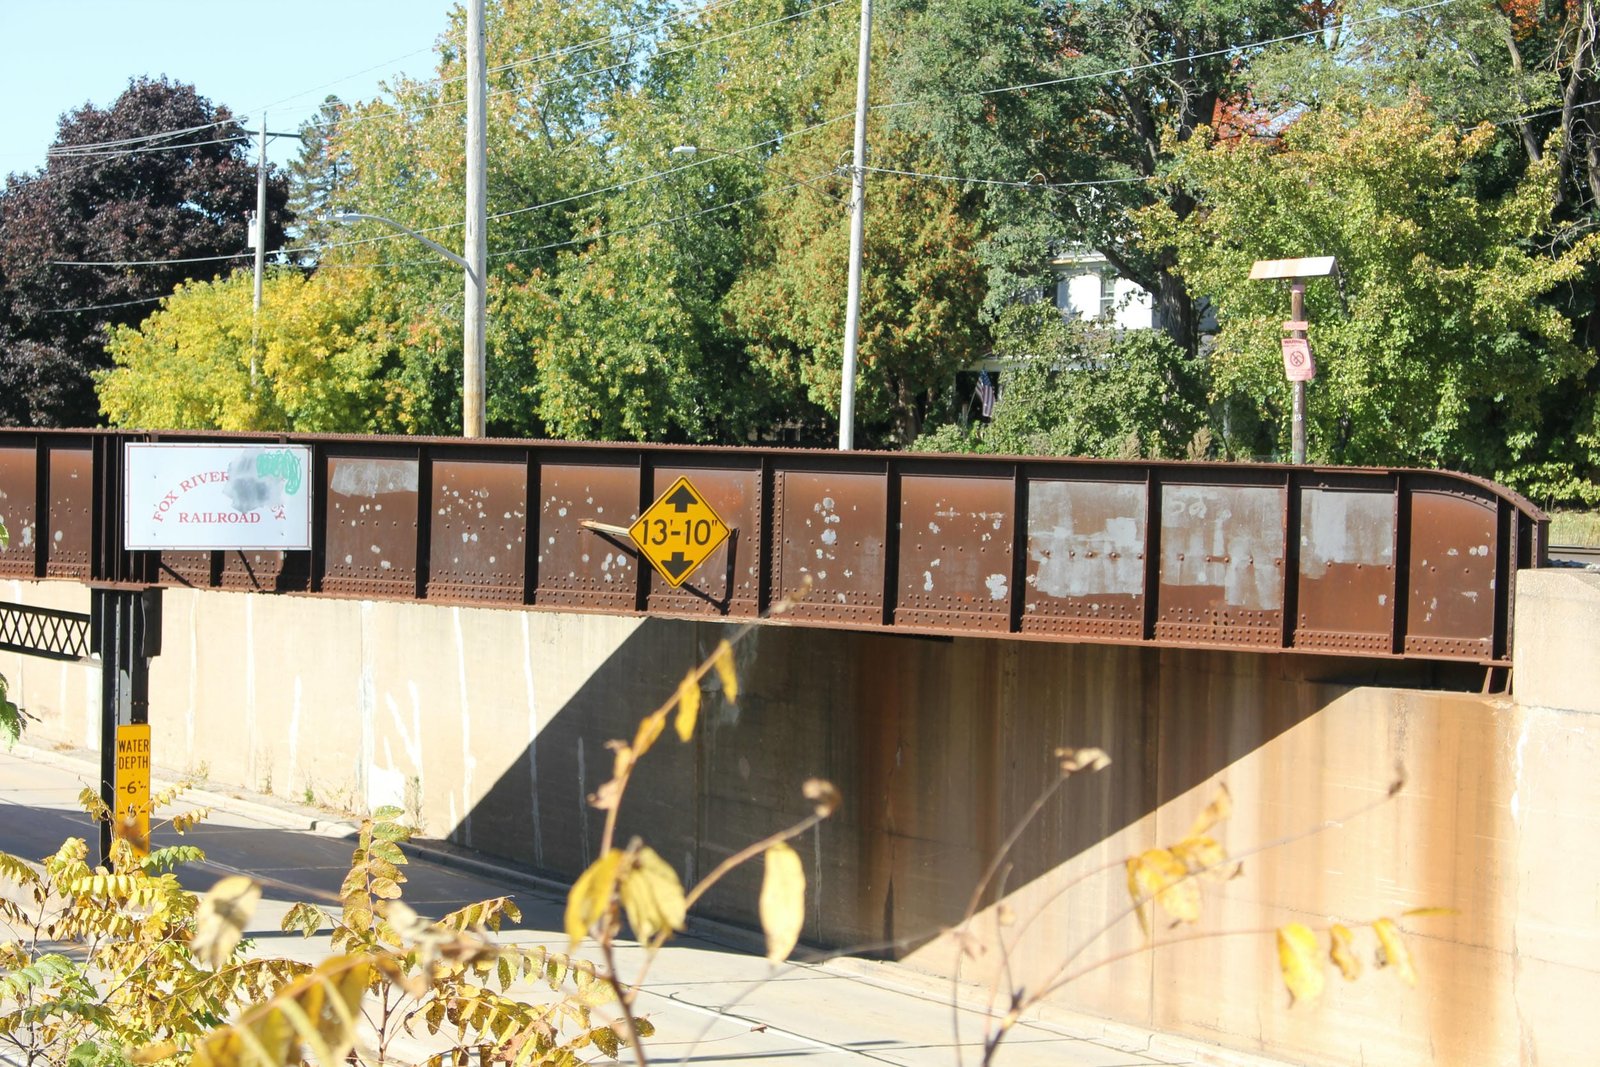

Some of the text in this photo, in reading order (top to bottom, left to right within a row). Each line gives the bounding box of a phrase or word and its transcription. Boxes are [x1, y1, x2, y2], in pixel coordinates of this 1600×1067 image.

[152, 490, 180, 523] FOX
[179, 512, 261, 524] RAILROAD
[642, 519, 718, 545] 13'-10"
[118, 739, 149, 752] WATER
[118, 756, 149, 770] DEPTH
